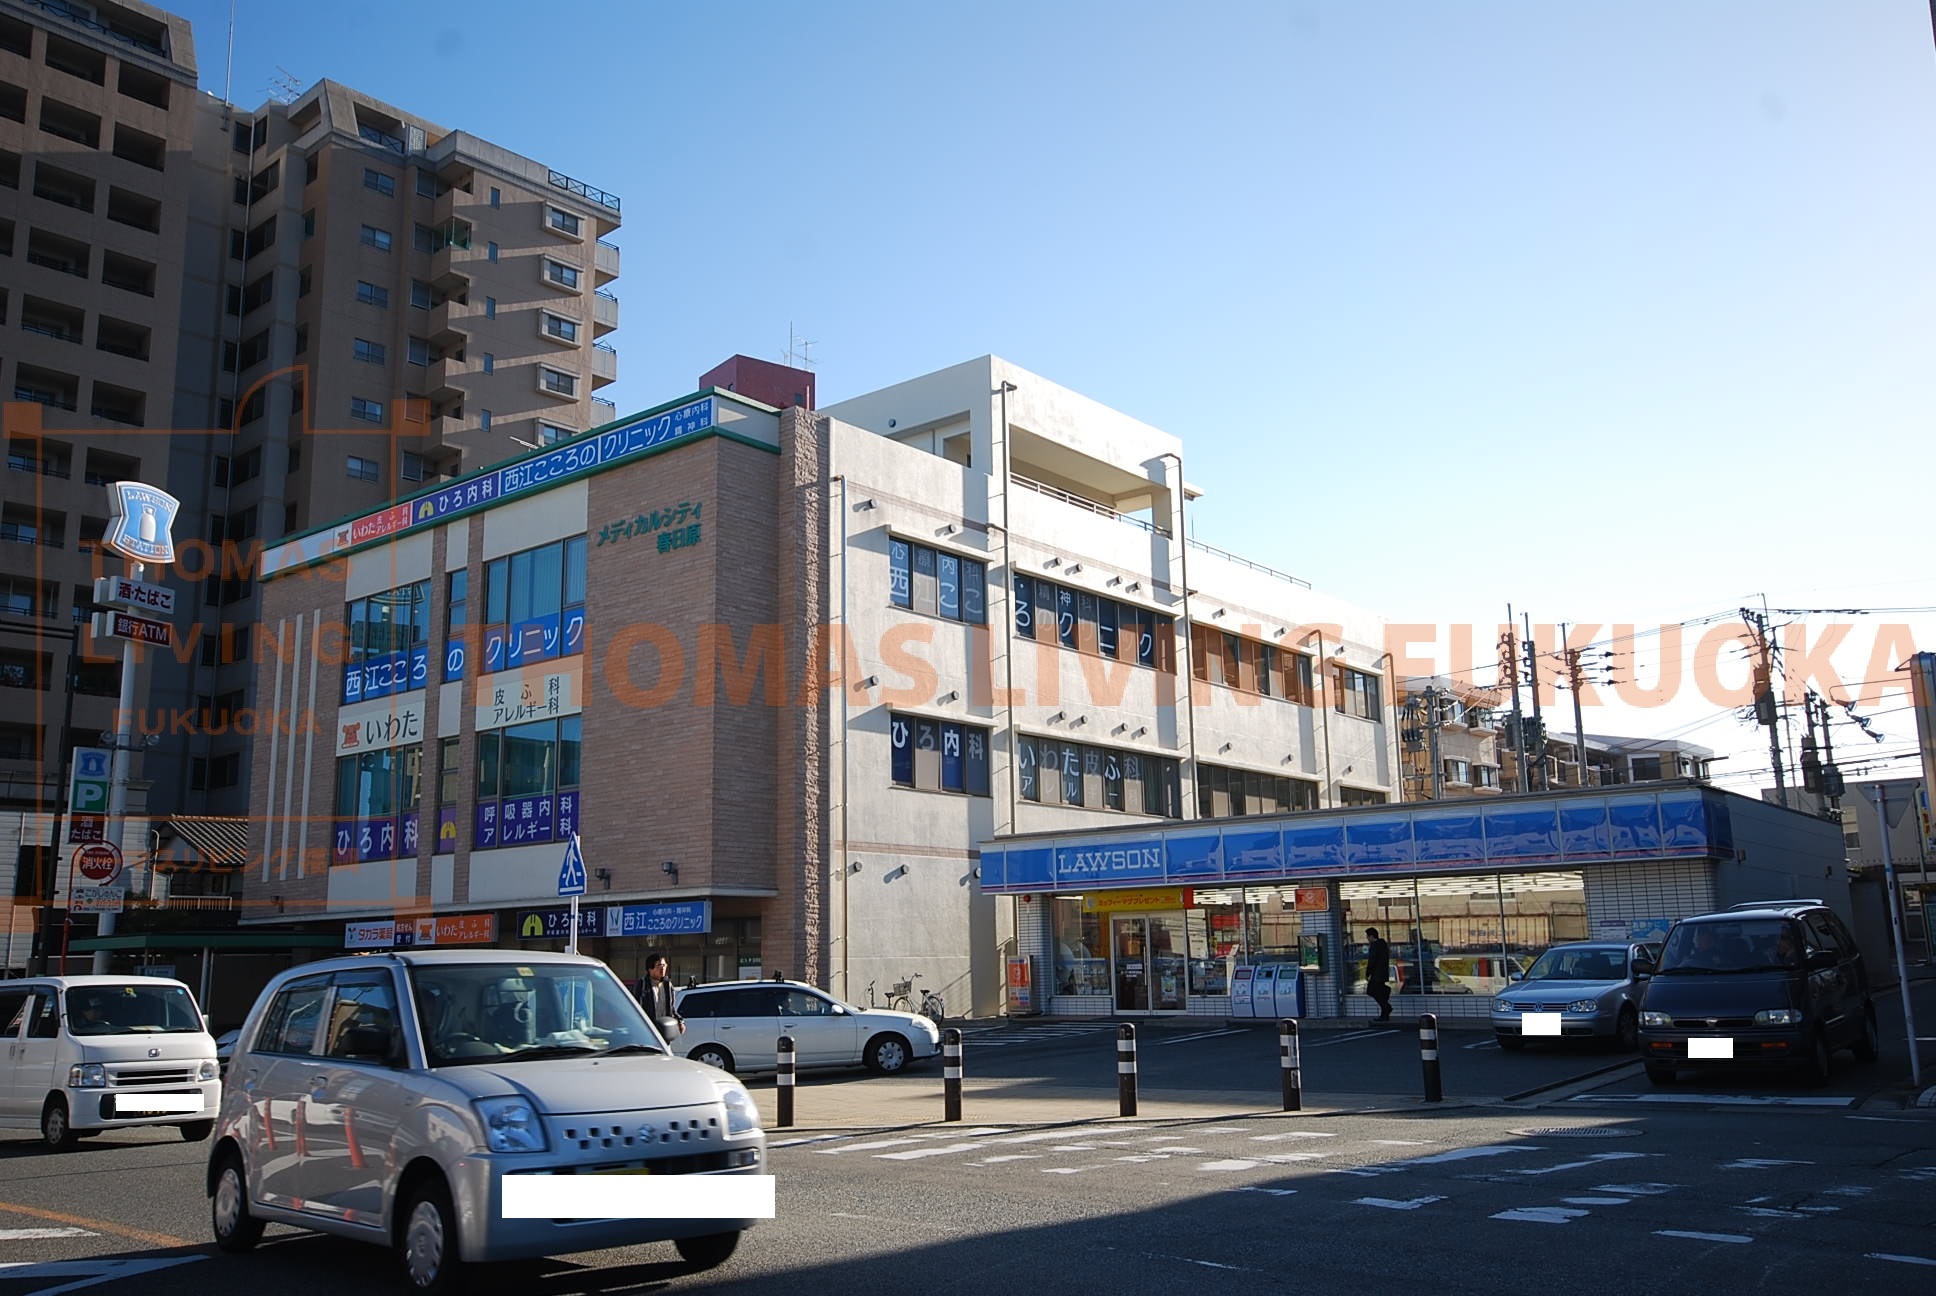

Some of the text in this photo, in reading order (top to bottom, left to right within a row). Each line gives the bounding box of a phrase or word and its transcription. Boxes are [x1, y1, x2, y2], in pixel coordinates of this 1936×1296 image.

[505, 415, 671, 493] 西江こころの クリニック
[125, 488, 173, 512] LAWSON
[439, 478, 493, 512] ひろ内科
[352, 520, 377, 540] いわた
[596, 502, 703, 548] メディカルシティ
[122, 534, 169, 556] STATION
[117, 618, 168, 642] 銀行ATM
[486, 616, 583, 665] クリニック
[495, 676, 560, 706] 皮ふ科
[493, 695, 560, 724] アレルギー科
[366, 710, 418, 745] いわた
[892, 721, 984, 761] ひろ内科
[76, 783, 103, 809] P
[484, 796, 572, 822] 呼吸器内科
[337, 819, 419, 856] ひろ内科
[483, 817, 572, 844] アレルギー科
[81, 856, 114, 871] 消火栓
[1058, 848, 1160, 873] LAWSON
[436, 925, 458, 937] いわた
[624, 911, 647, 931] 西江
[647, 915, 703, 931] こころのクリニック
